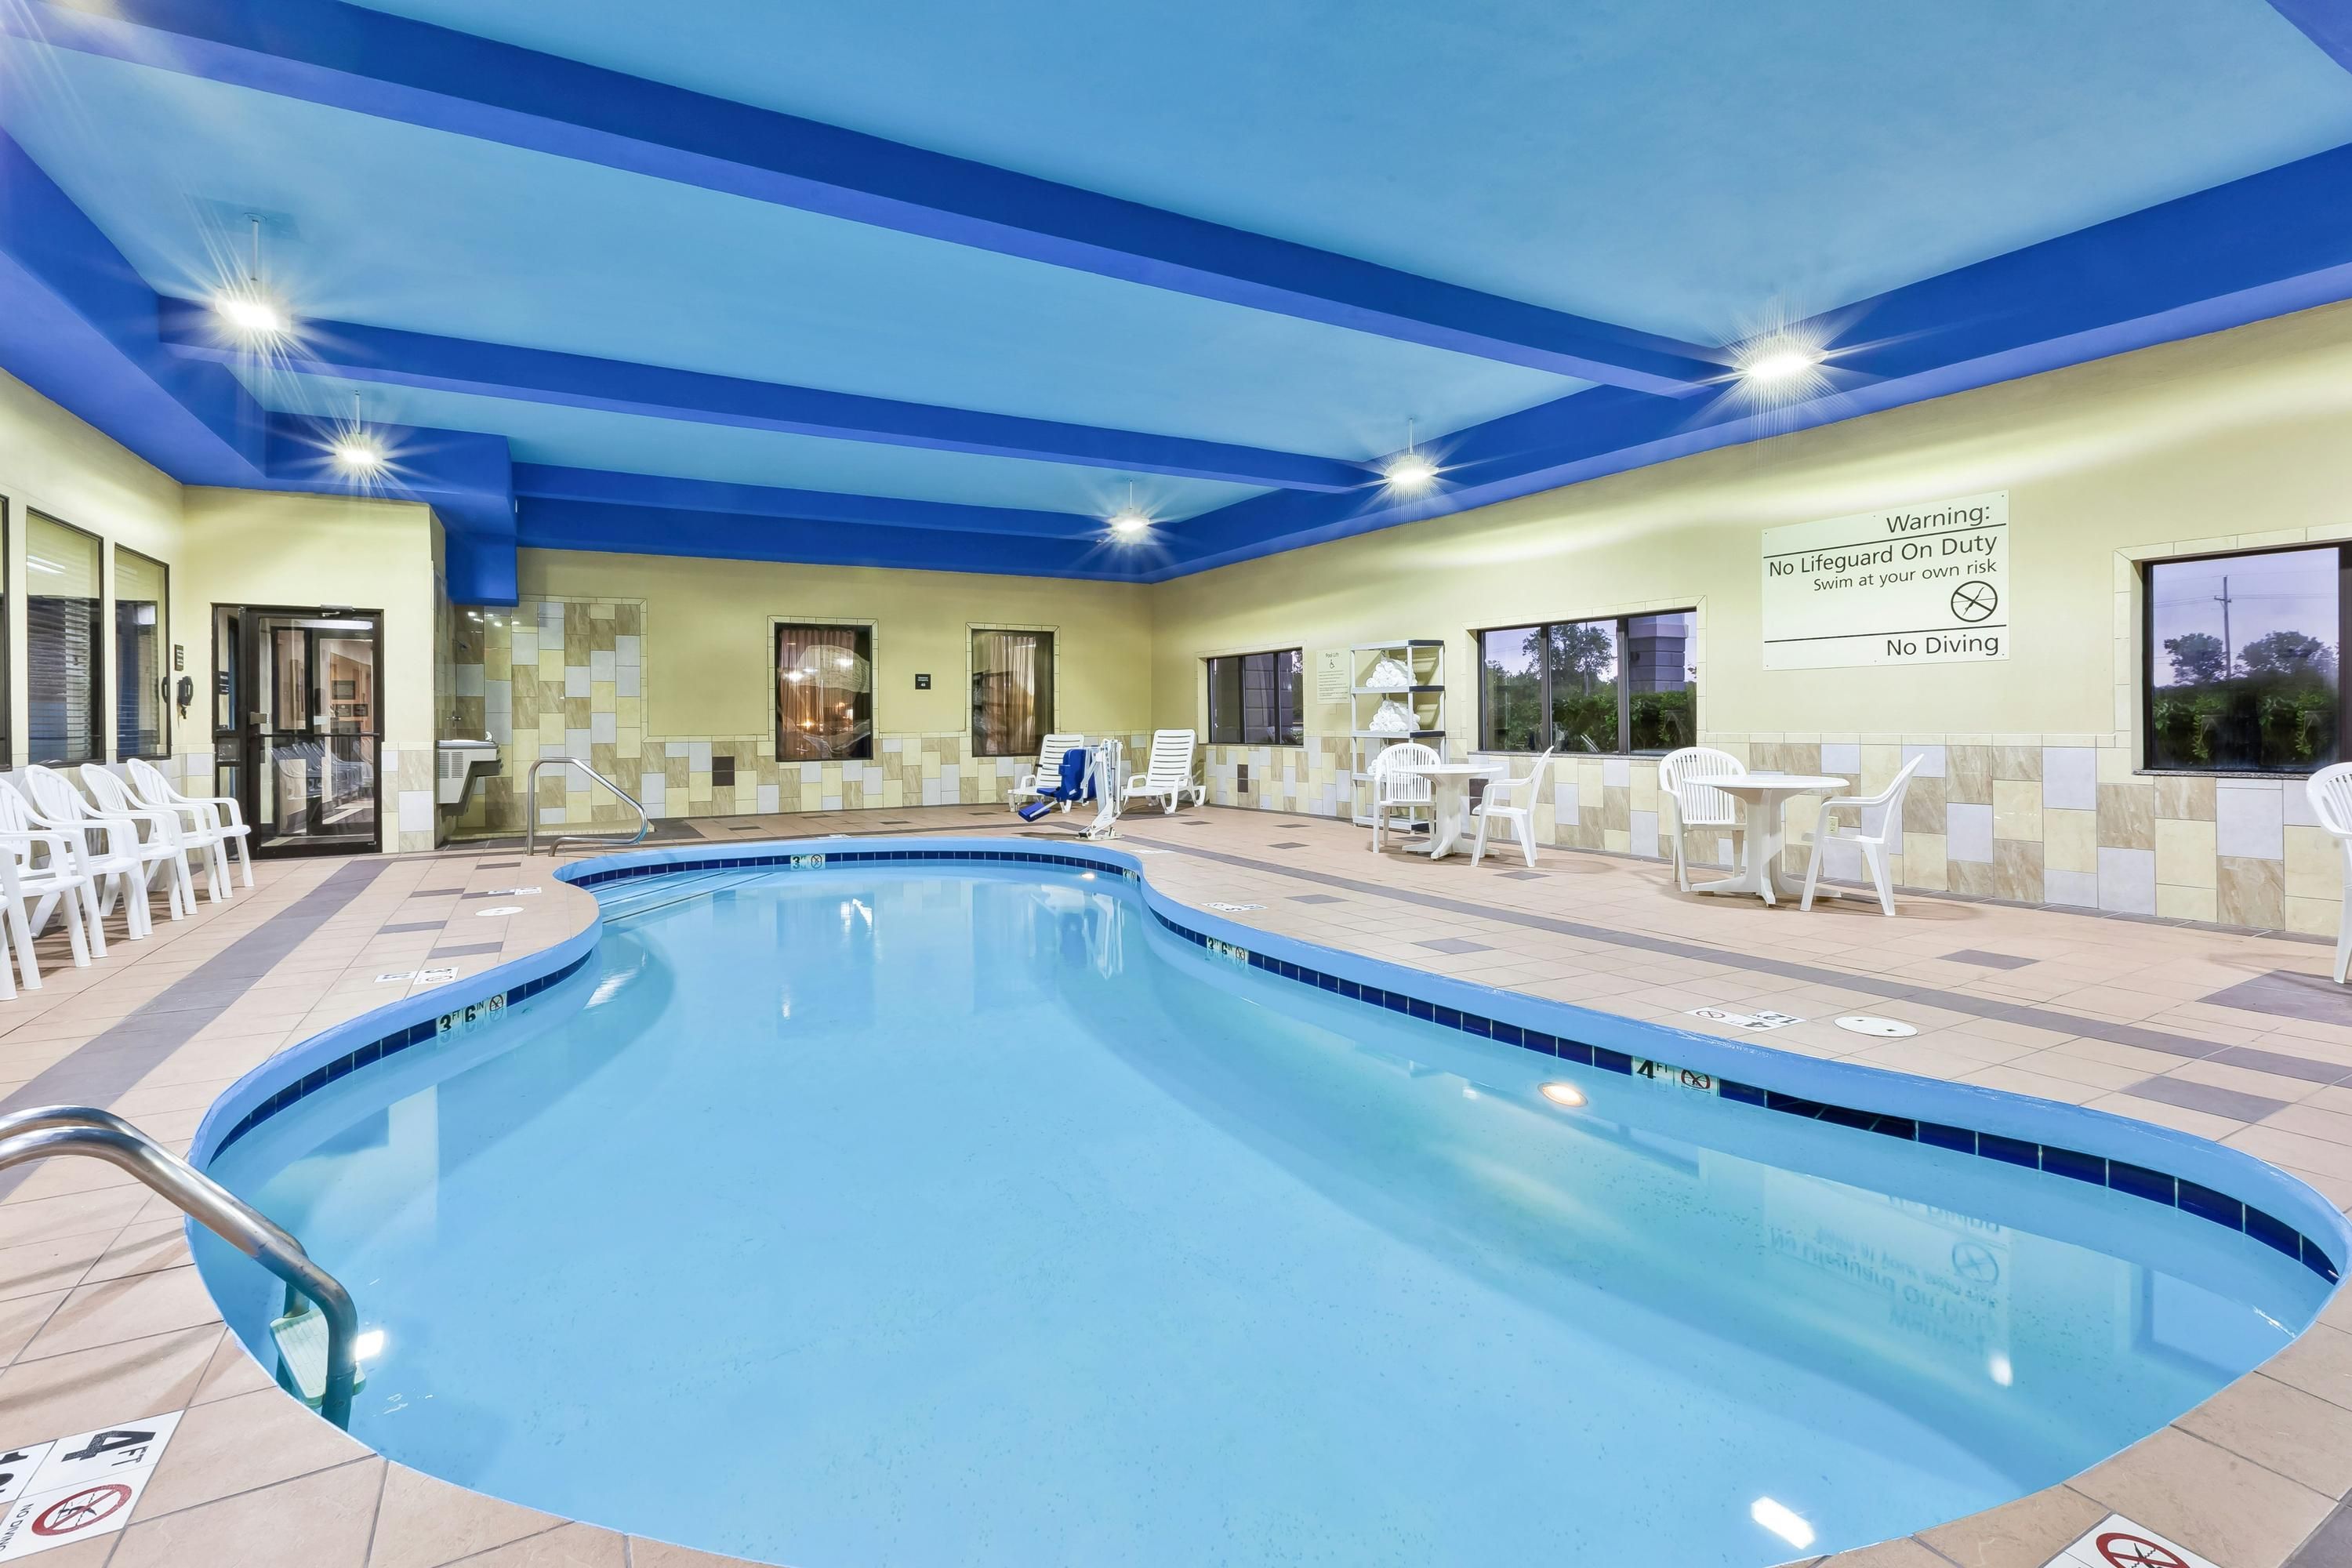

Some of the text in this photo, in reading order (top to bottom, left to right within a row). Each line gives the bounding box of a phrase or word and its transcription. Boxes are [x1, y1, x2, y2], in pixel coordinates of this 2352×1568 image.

[1886, 506, 1990, 533] Warning:
[1769, 535, 1998, 576] No Lifeguard On Duty
[1813, 558, 1997, 591] Swim at your own risk
[1886, 634, 1999, 656] No Diving
[439, 1000, 485, 1033] 3 FT 6 IN
[1636, 1059, 1656, 1079] 4
[61, 1430, 156, 1466] 4 FT
[16, 1503, 34, 1519] NO
